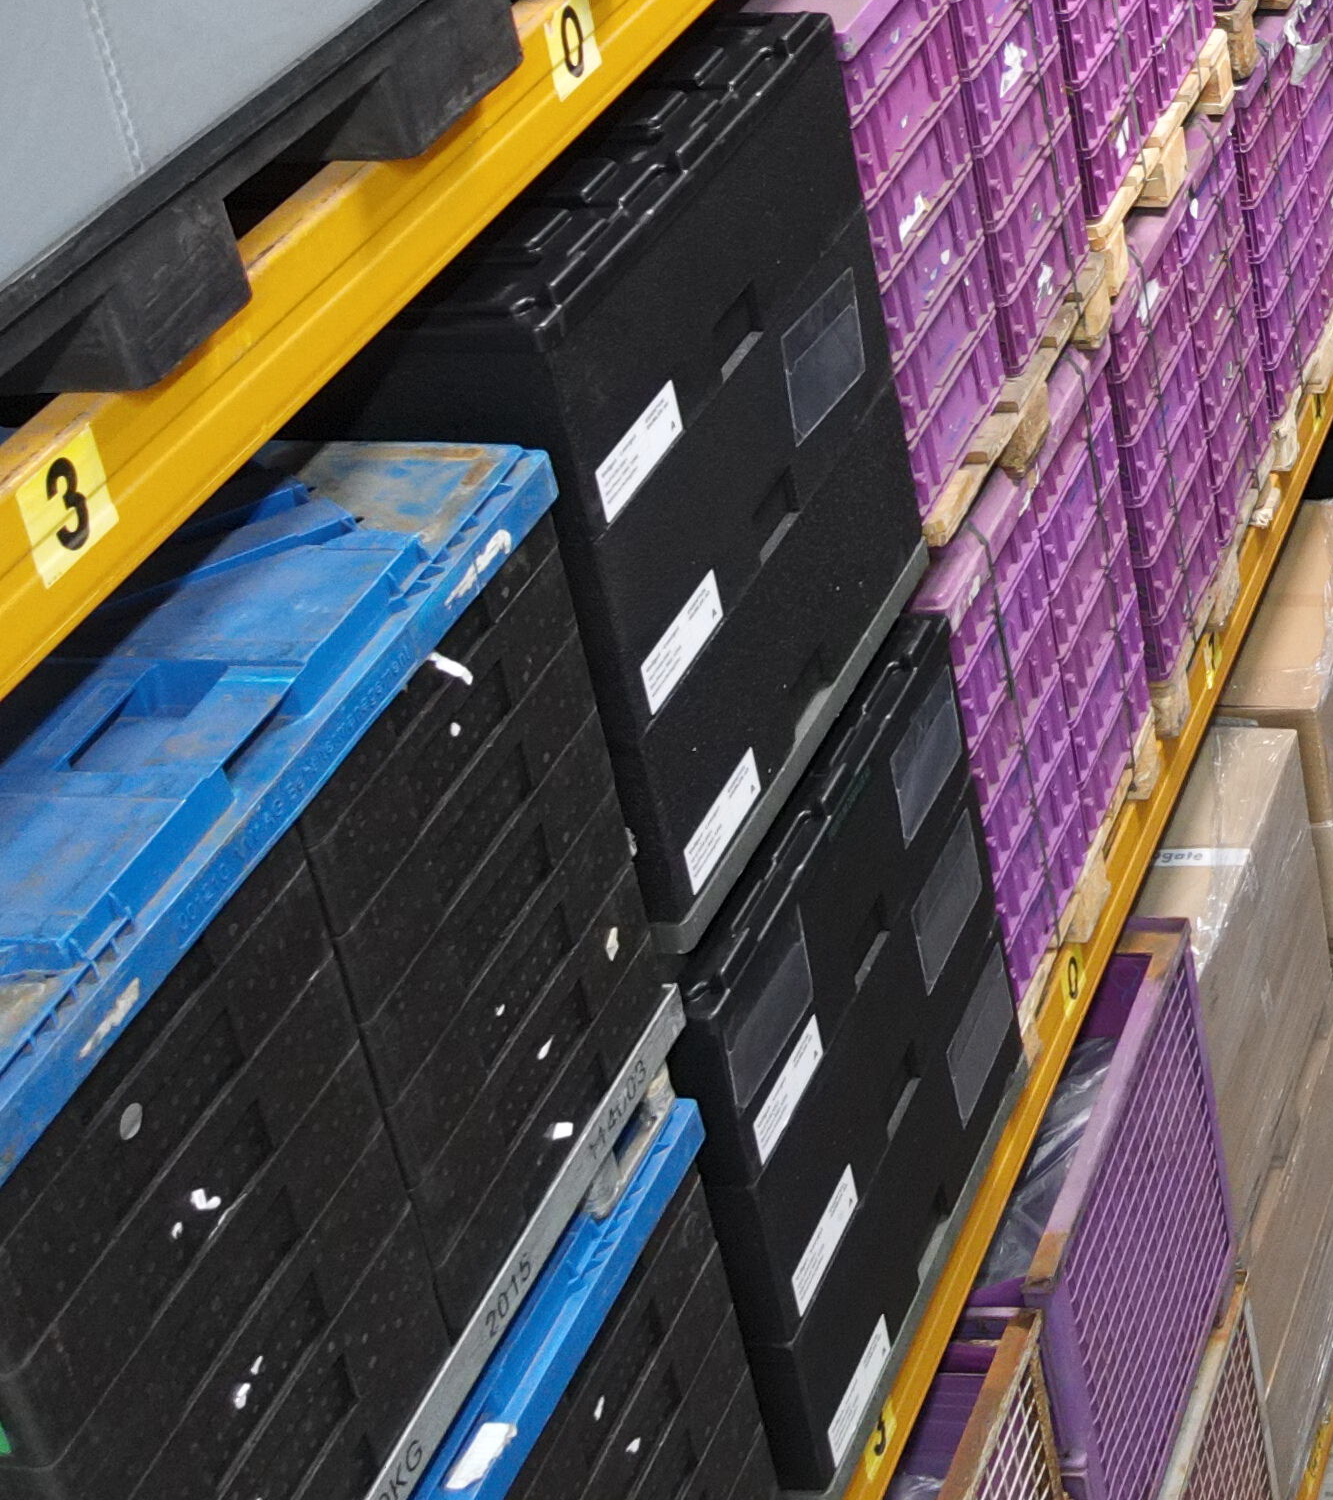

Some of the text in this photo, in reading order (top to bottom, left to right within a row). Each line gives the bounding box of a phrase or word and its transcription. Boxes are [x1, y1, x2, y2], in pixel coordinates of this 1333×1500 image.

[560, 5, 583, 78] 0
[45, 457, 90, 552] 3
[484, 1255, 533, 1339] 2015
